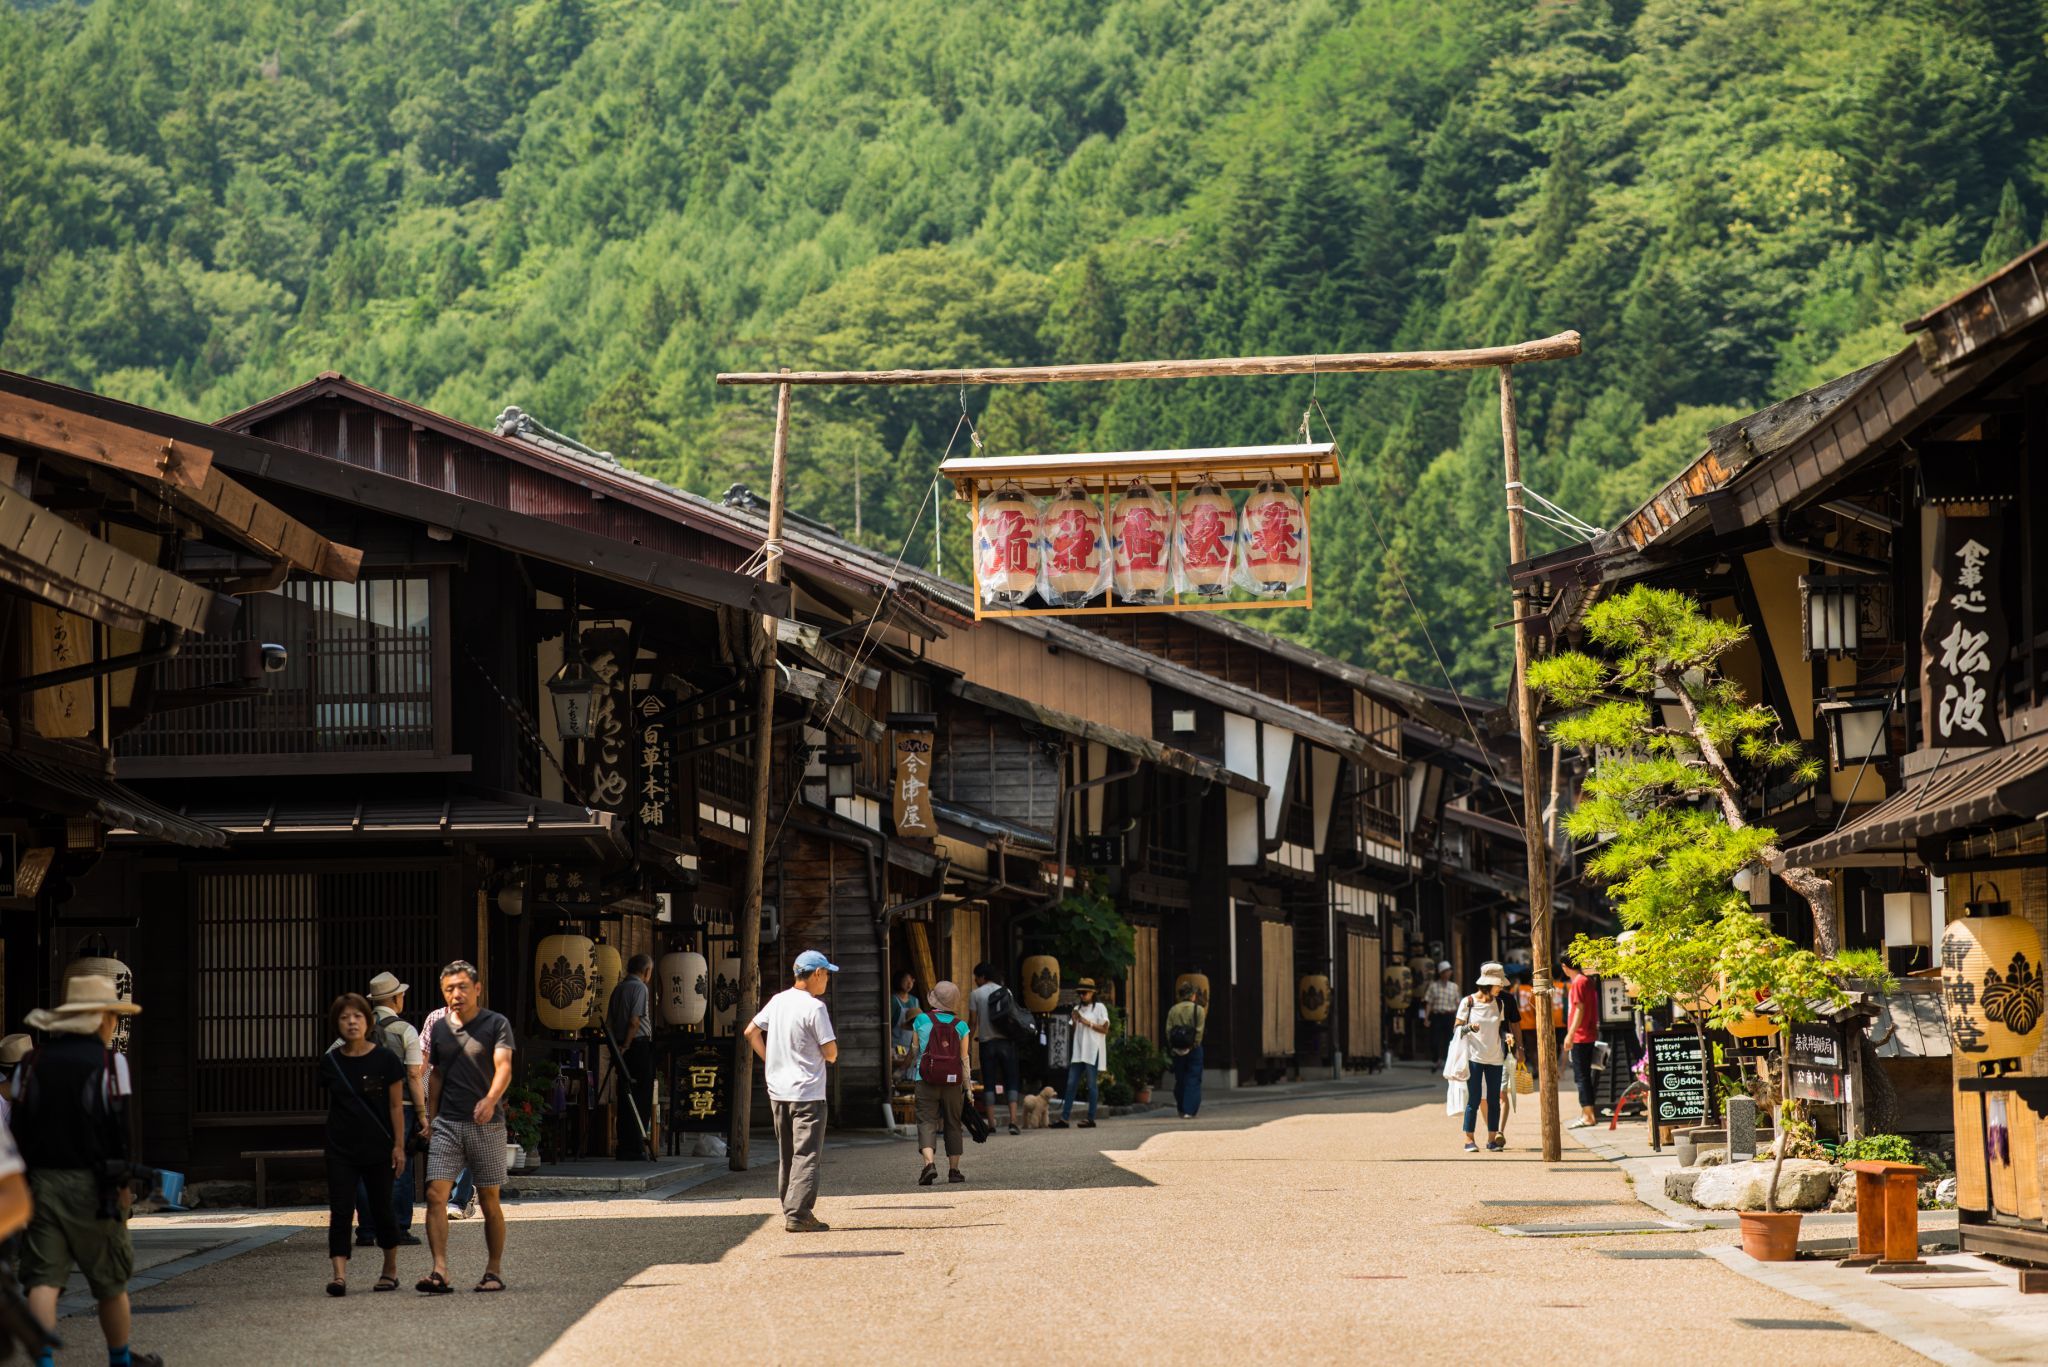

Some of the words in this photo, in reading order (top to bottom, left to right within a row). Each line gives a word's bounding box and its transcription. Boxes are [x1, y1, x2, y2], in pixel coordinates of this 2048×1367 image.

[1939, 620, 1991, 739] 松波
[638, 722, 665, 826] 百草本舗
[899, 753, 927, 828] 会津屋
[688, 1065, 719, 1121] 百草
[1797, 1070, 1829, 1085] 公衆トイレ
